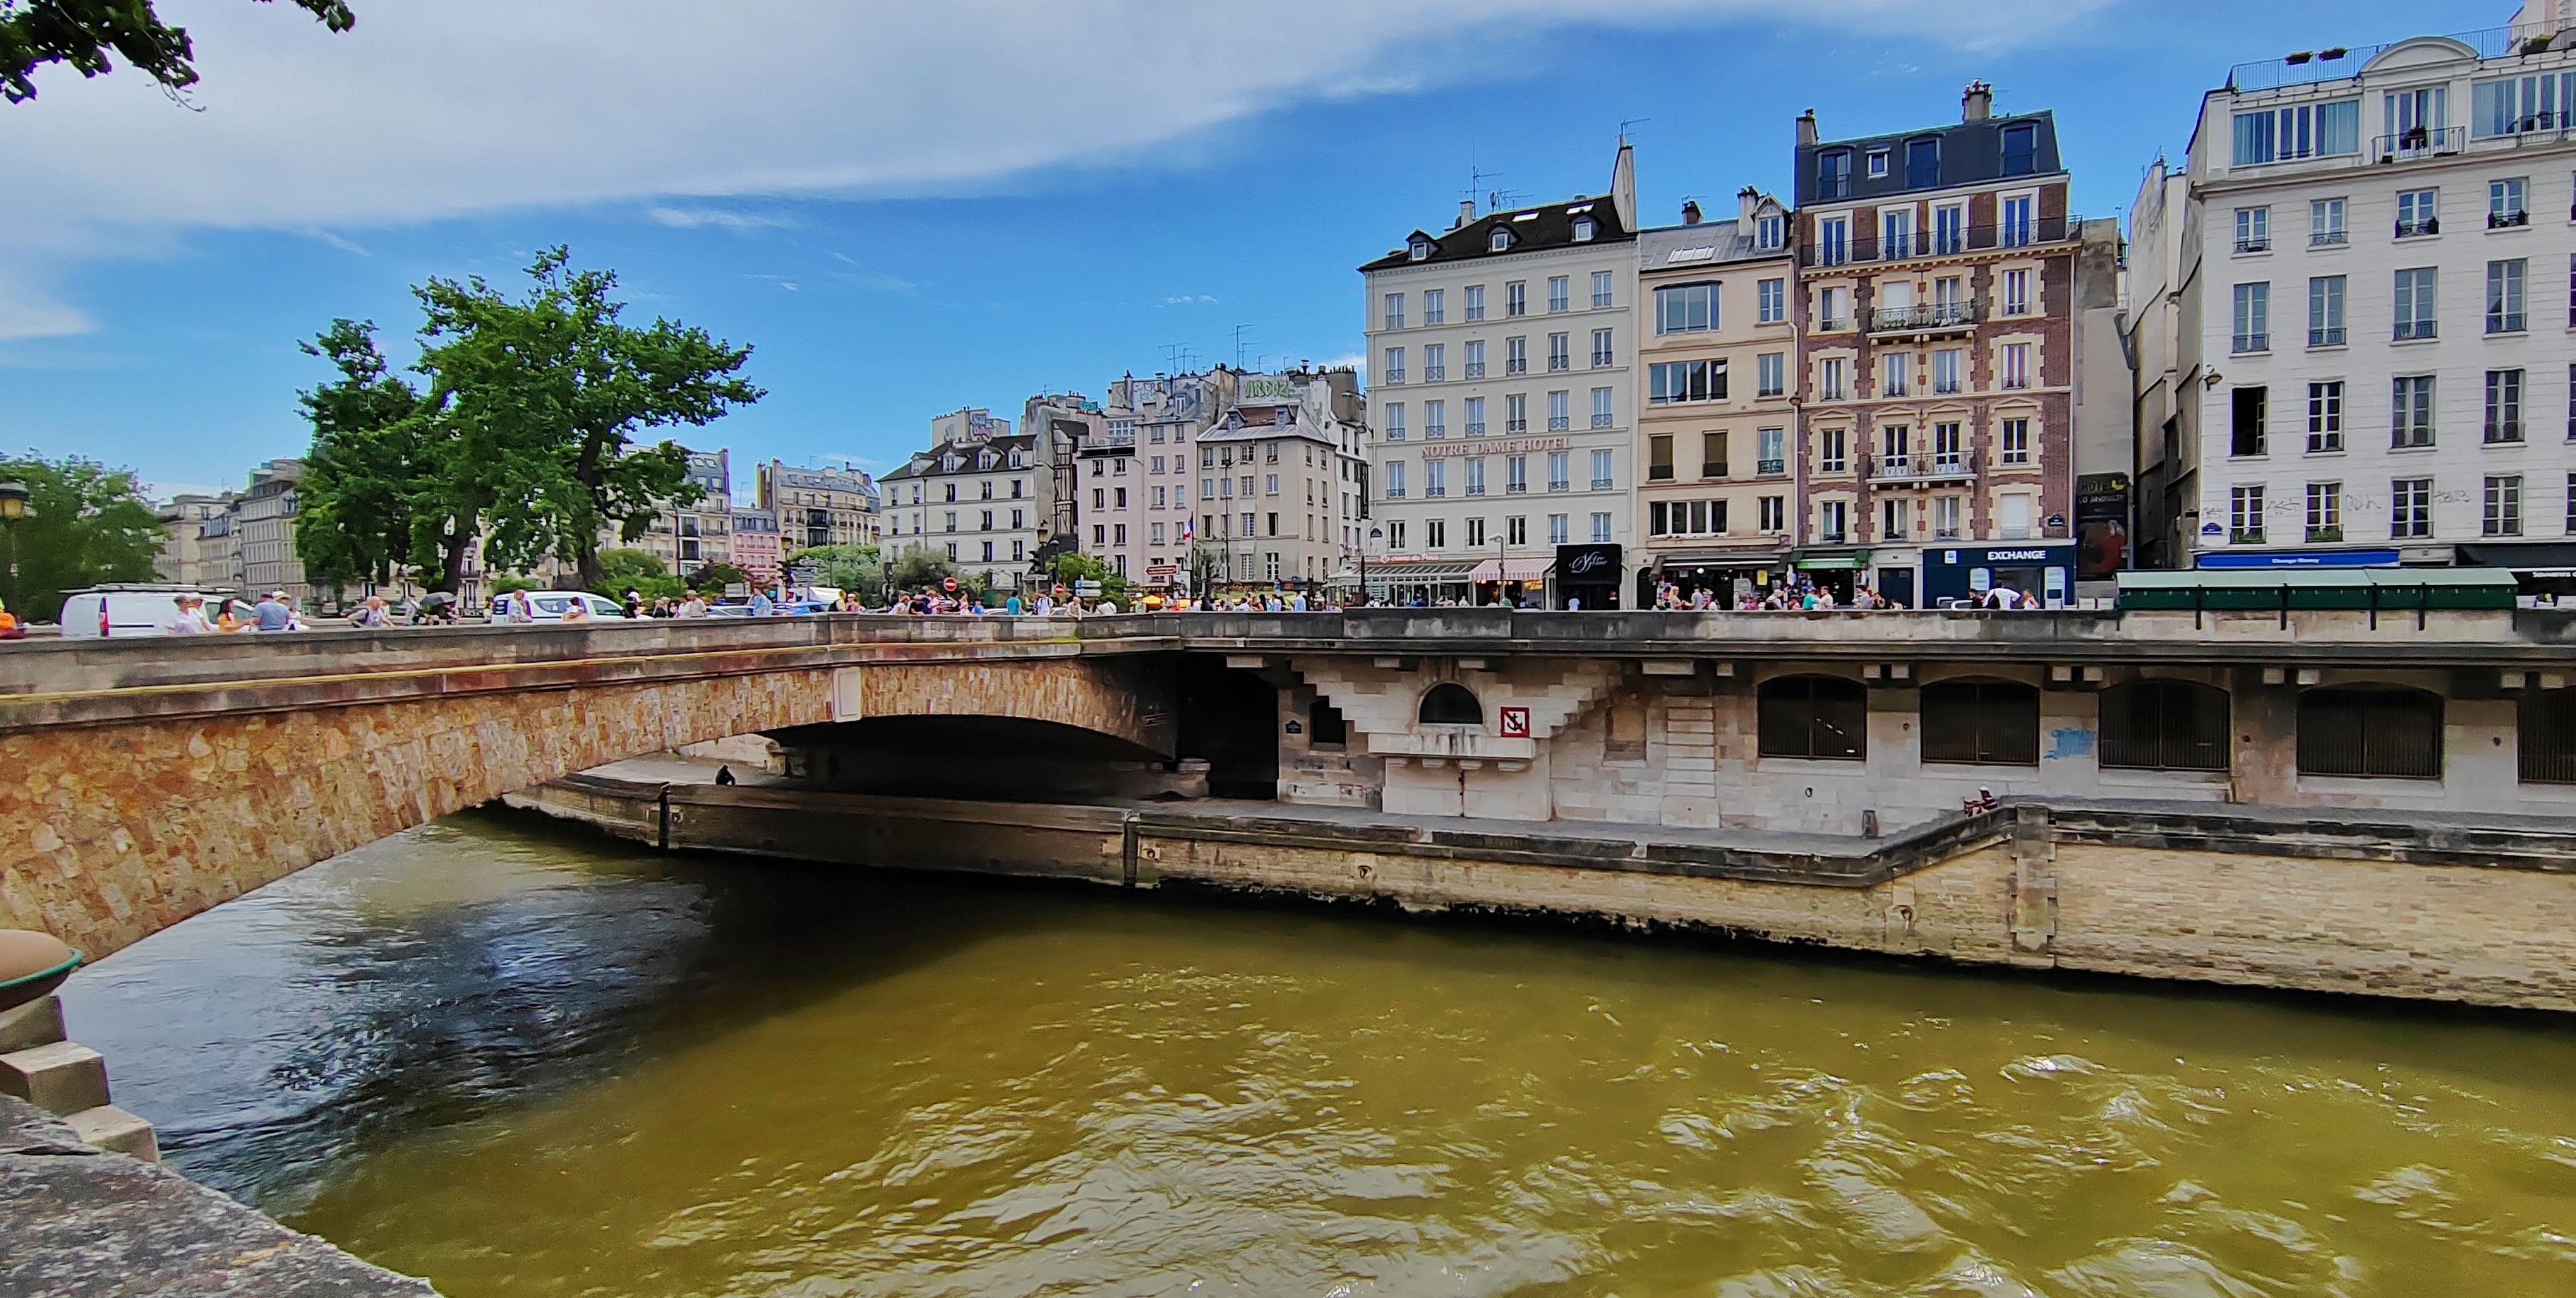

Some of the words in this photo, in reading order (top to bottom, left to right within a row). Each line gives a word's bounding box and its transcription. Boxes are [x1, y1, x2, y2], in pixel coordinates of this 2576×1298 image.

[1422, 443, 1468, 458] NOTRE
[1476, 440, 1515, 455] DAME
[1522, 437, 1570, 452] HOTEL
[1987, 551, 2046, 560] EXCHANGE
